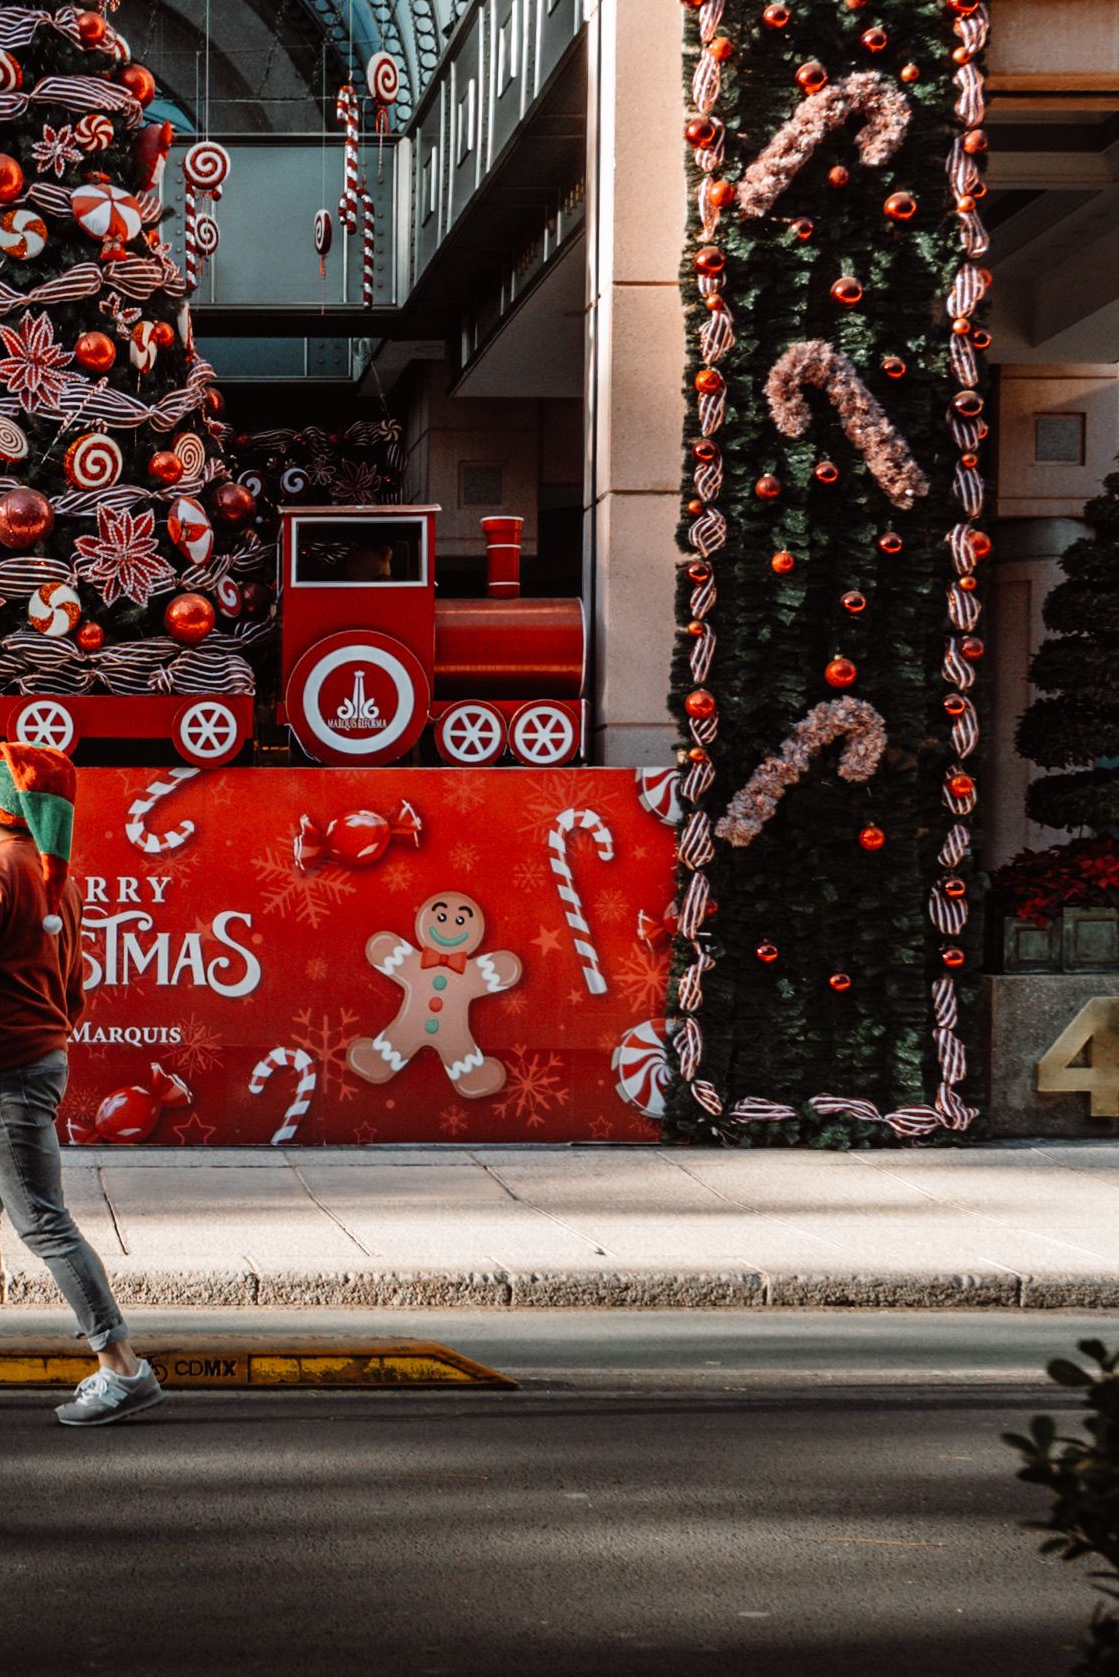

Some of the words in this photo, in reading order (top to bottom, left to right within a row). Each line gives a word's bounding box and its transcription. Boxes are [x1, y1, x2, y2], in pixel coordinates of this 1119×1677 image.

[71, 876, 172, 904] RRY
[67, 1022, 181, 1047] MARQUIS
[174, 1360, 236, 1377] CDMX
